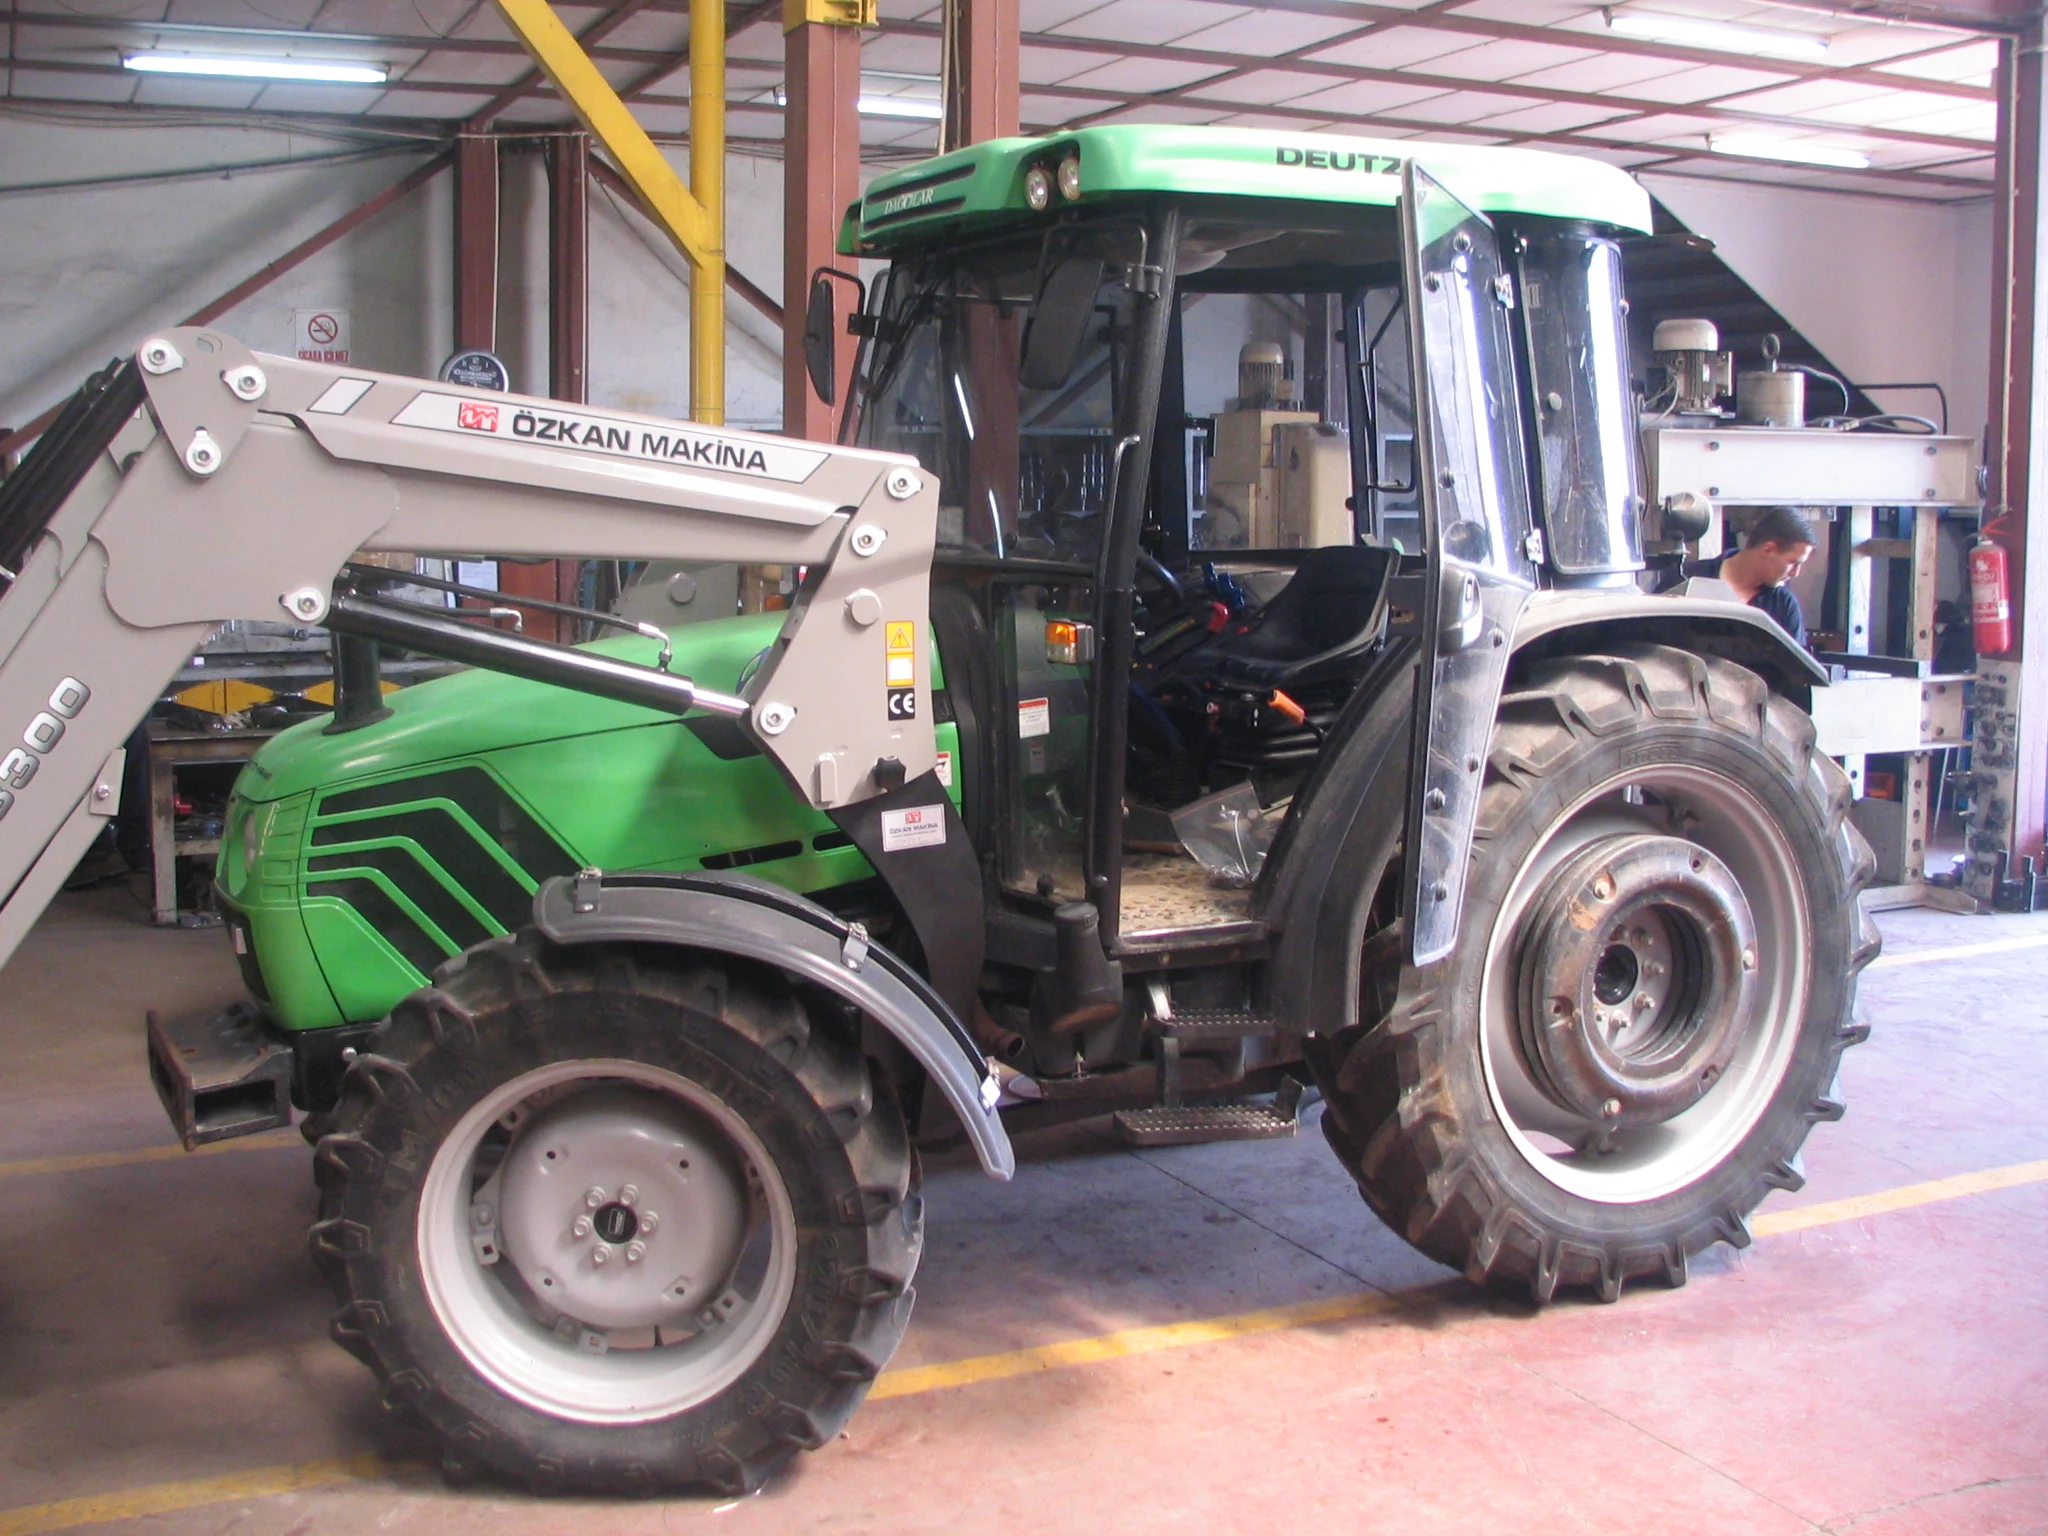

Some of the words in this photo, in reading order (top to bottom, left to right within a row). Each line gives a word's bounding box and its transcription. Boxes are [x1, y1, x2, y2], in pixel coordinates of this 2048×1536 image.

[1276, 146, 1402, 176] DEUTZ
[512, 409, 631, 451] ÖZKAN
[641, 432, 768, 472] MAKİNA
[889, 693, 914, 714] CE
